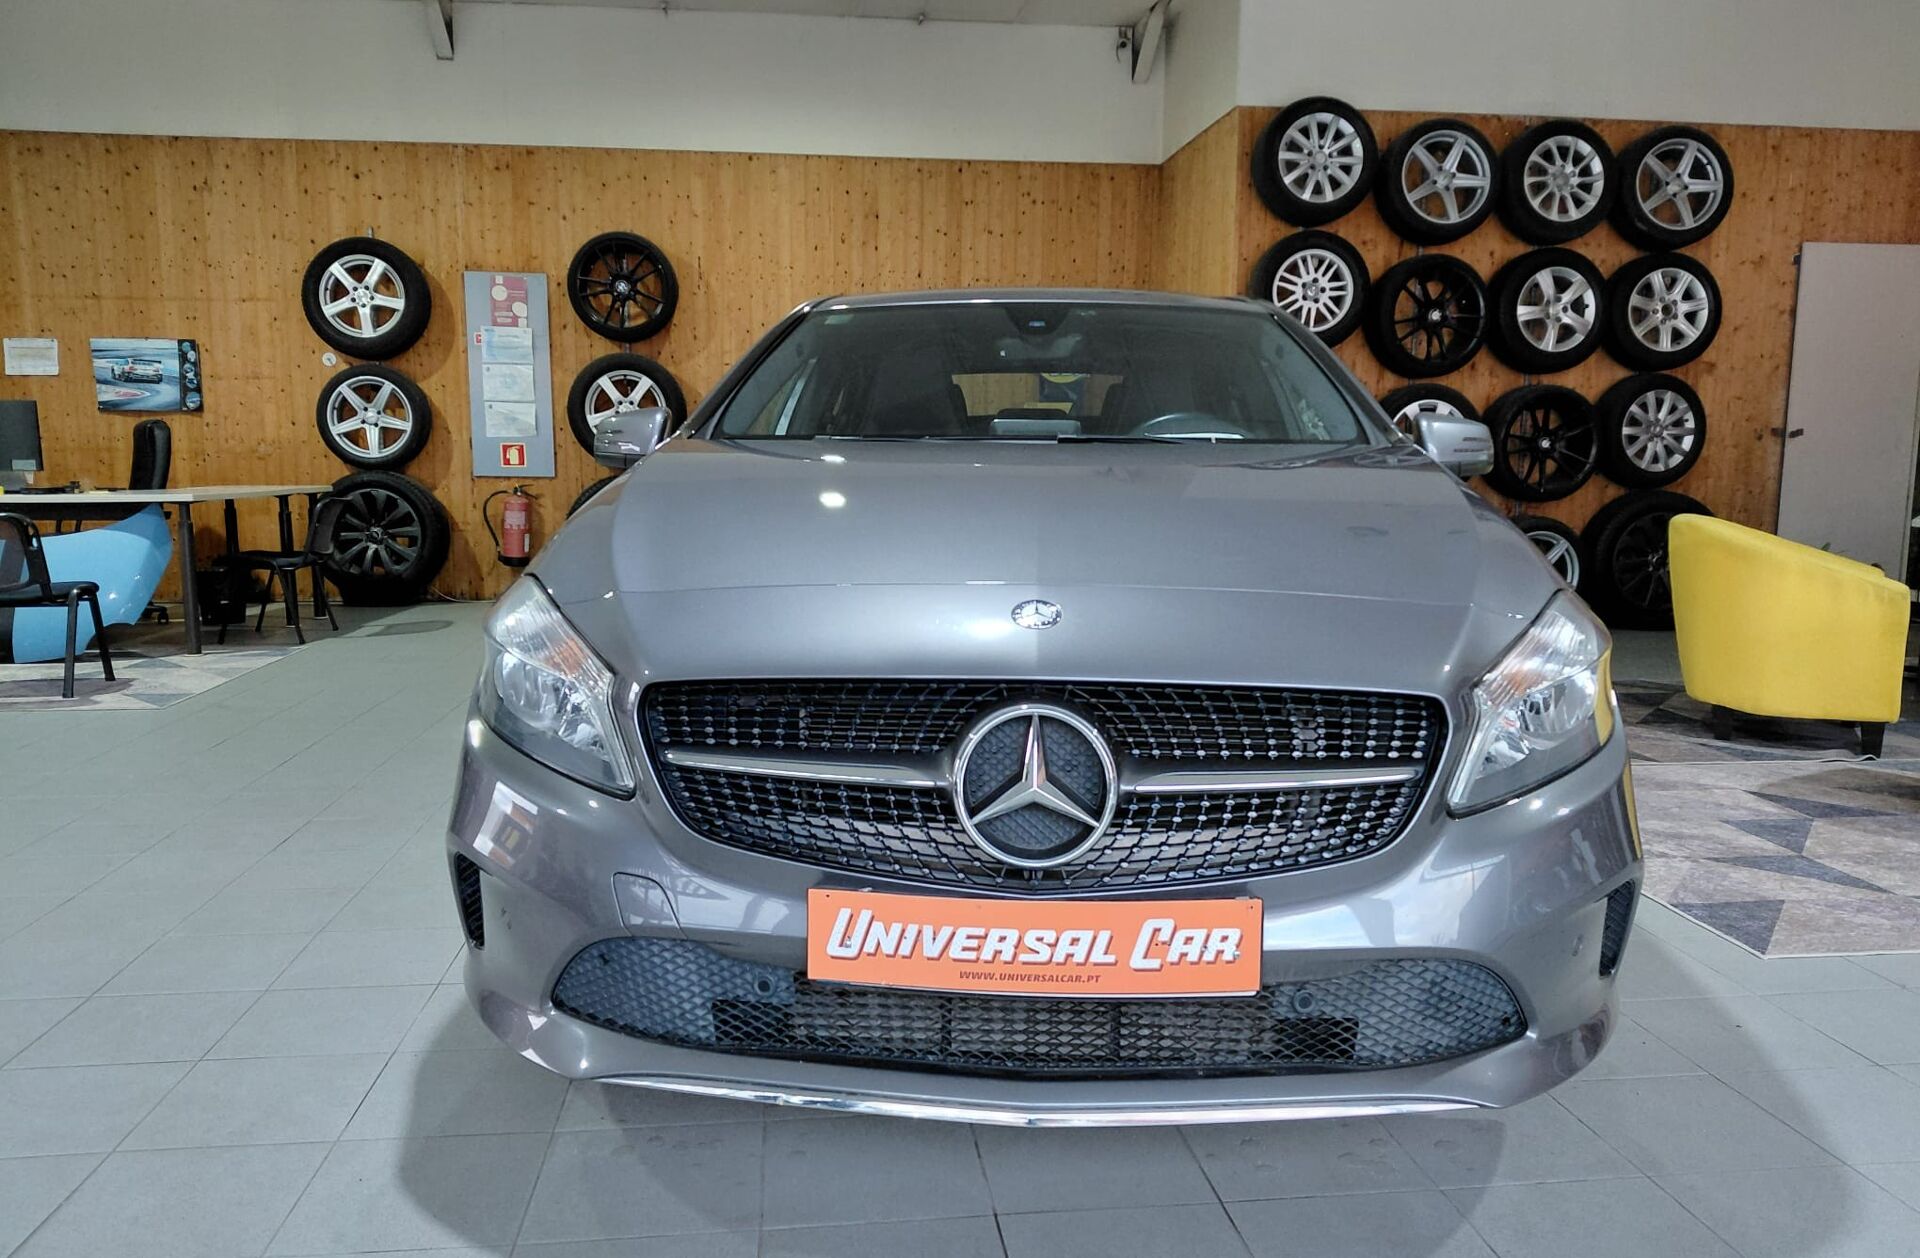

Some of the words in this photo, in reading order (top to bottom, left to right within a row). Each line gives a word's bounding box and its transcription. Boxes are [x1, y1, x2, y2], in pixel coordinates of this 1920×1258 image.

[826, 907, 1118, 965] UNIVERSAL
[1129, 918, 1242, 971] CAR
[959, 970, 1102, 984] WWW.UNIVERSALCAR.PT
